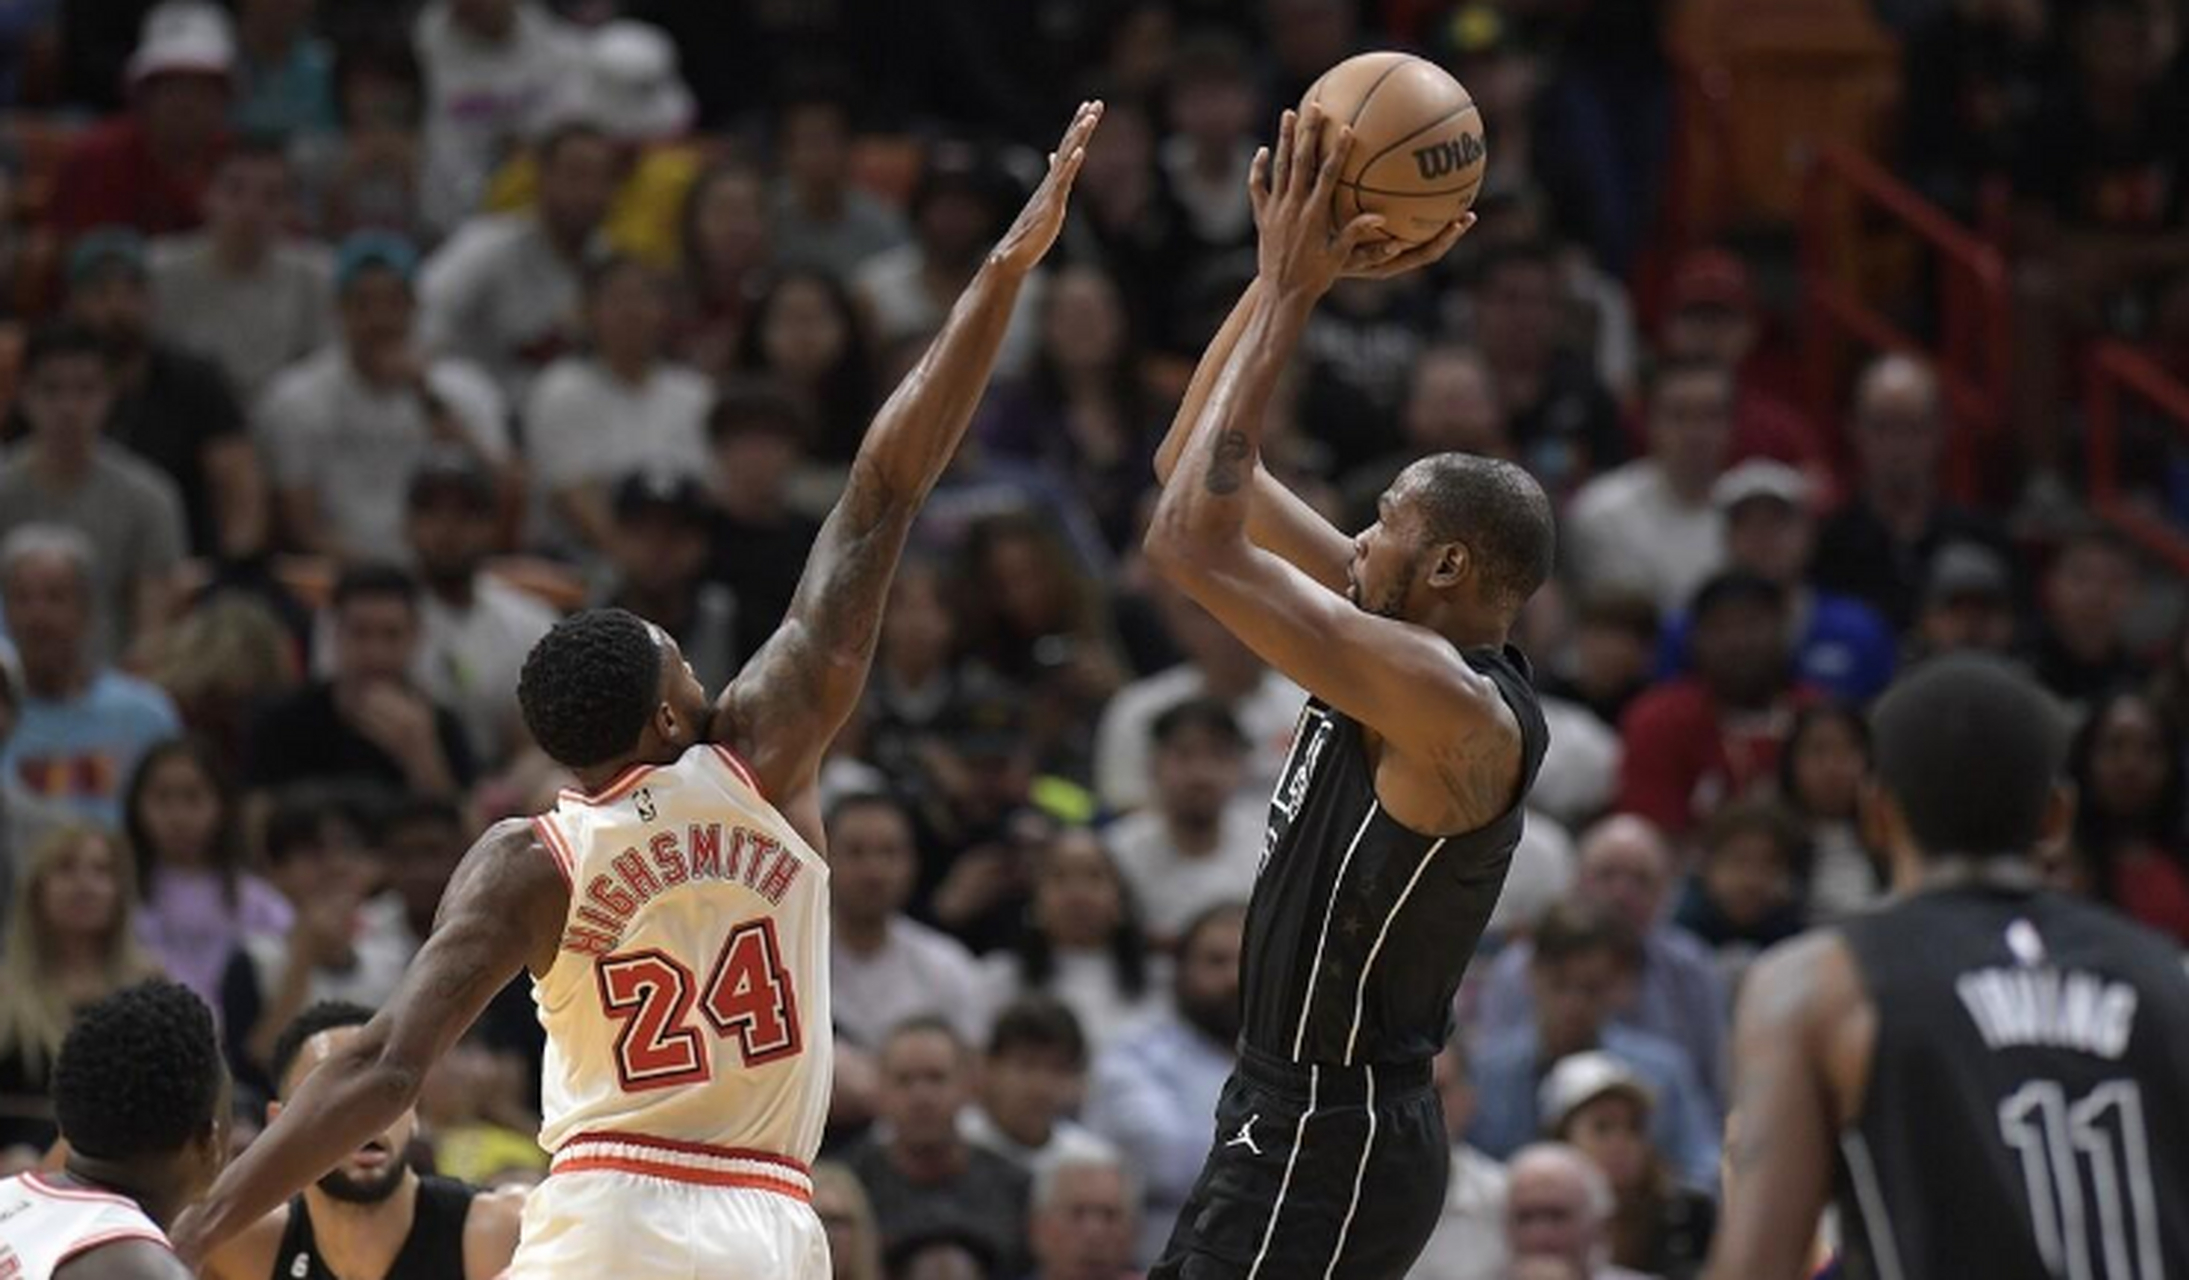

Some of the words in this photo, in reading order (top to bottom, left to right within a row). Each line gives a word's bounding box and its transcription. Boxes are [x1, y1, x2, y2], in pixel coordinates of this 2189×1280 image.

[564, 823, 803, 955] HIGHSMITH
[595, 916, 803, 1093] 24
[1999, 1079, 2166, 1280] 11
